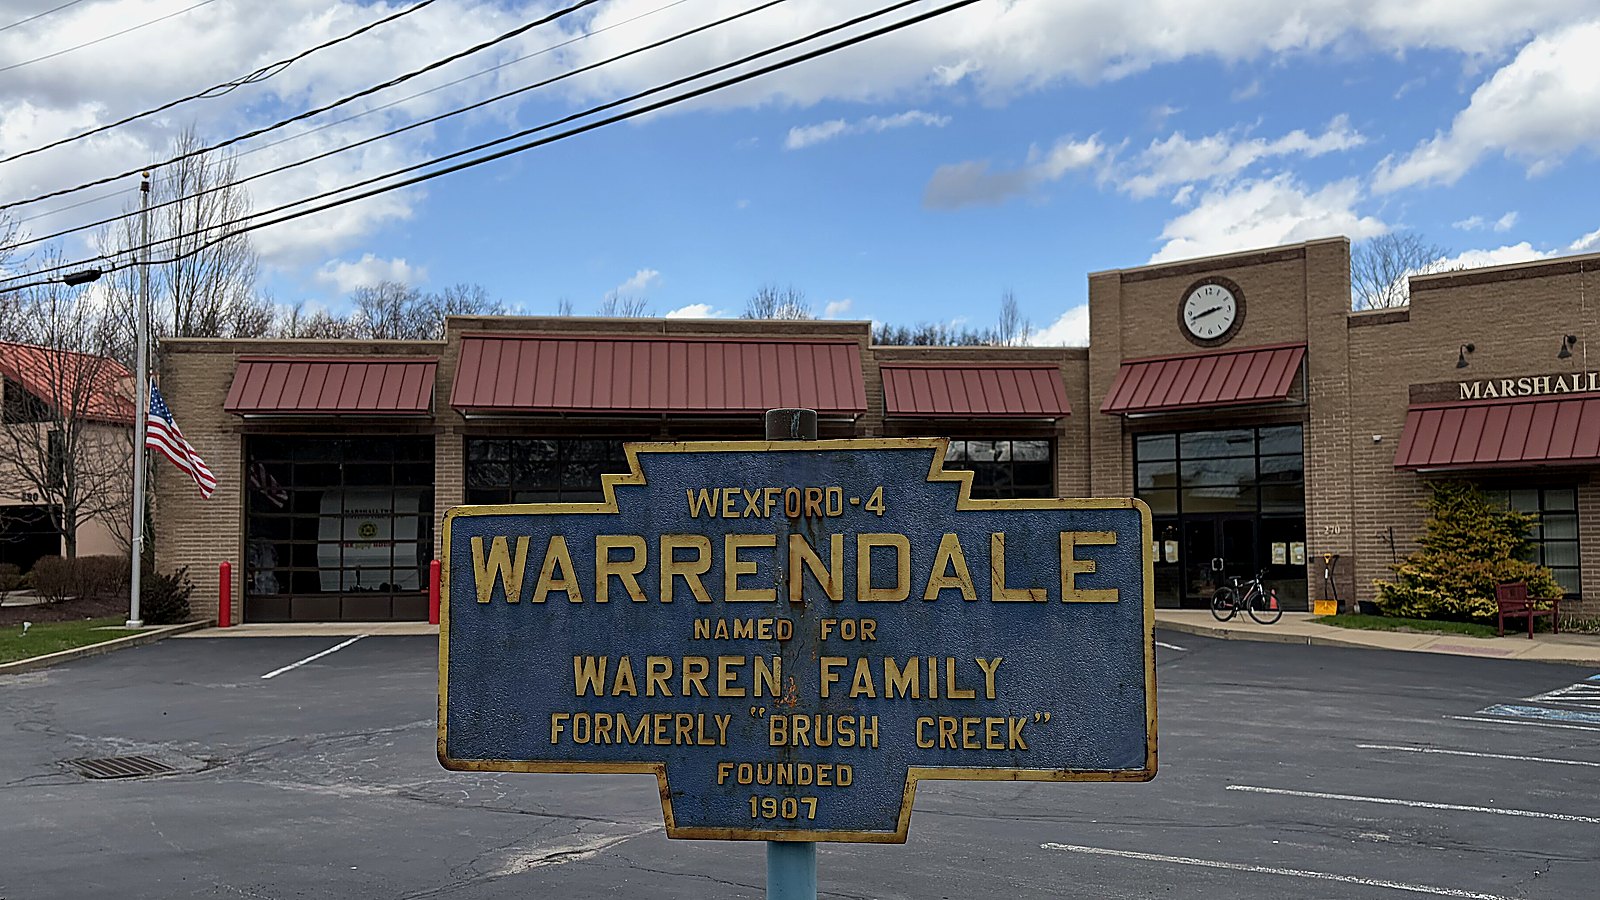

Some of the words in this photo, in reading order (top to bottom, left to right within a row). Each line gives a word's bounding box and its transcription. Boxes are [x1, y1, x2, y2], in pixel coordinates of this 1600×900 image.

[1205, 287, 1213, 295] 12
[1459, 372, 1600, 400] MARSHALL
[686, 486, 886, 519] WEXFORD-4
[1324, 525, 1341, 535] 270
[470, 531, 1120, 605] WARRENDALE
[693, 617, 794, 641] NAMED
[820, 618, 878, 641] FOR
[573, 655, 783, 698] WARREN
[820, 656, 1004, 700] FAMILY
[551, 712, 733, 746] FORMERLY
[717, 761, 854, 787] FOUNDED
[749, 795, 819, 820] 1907
